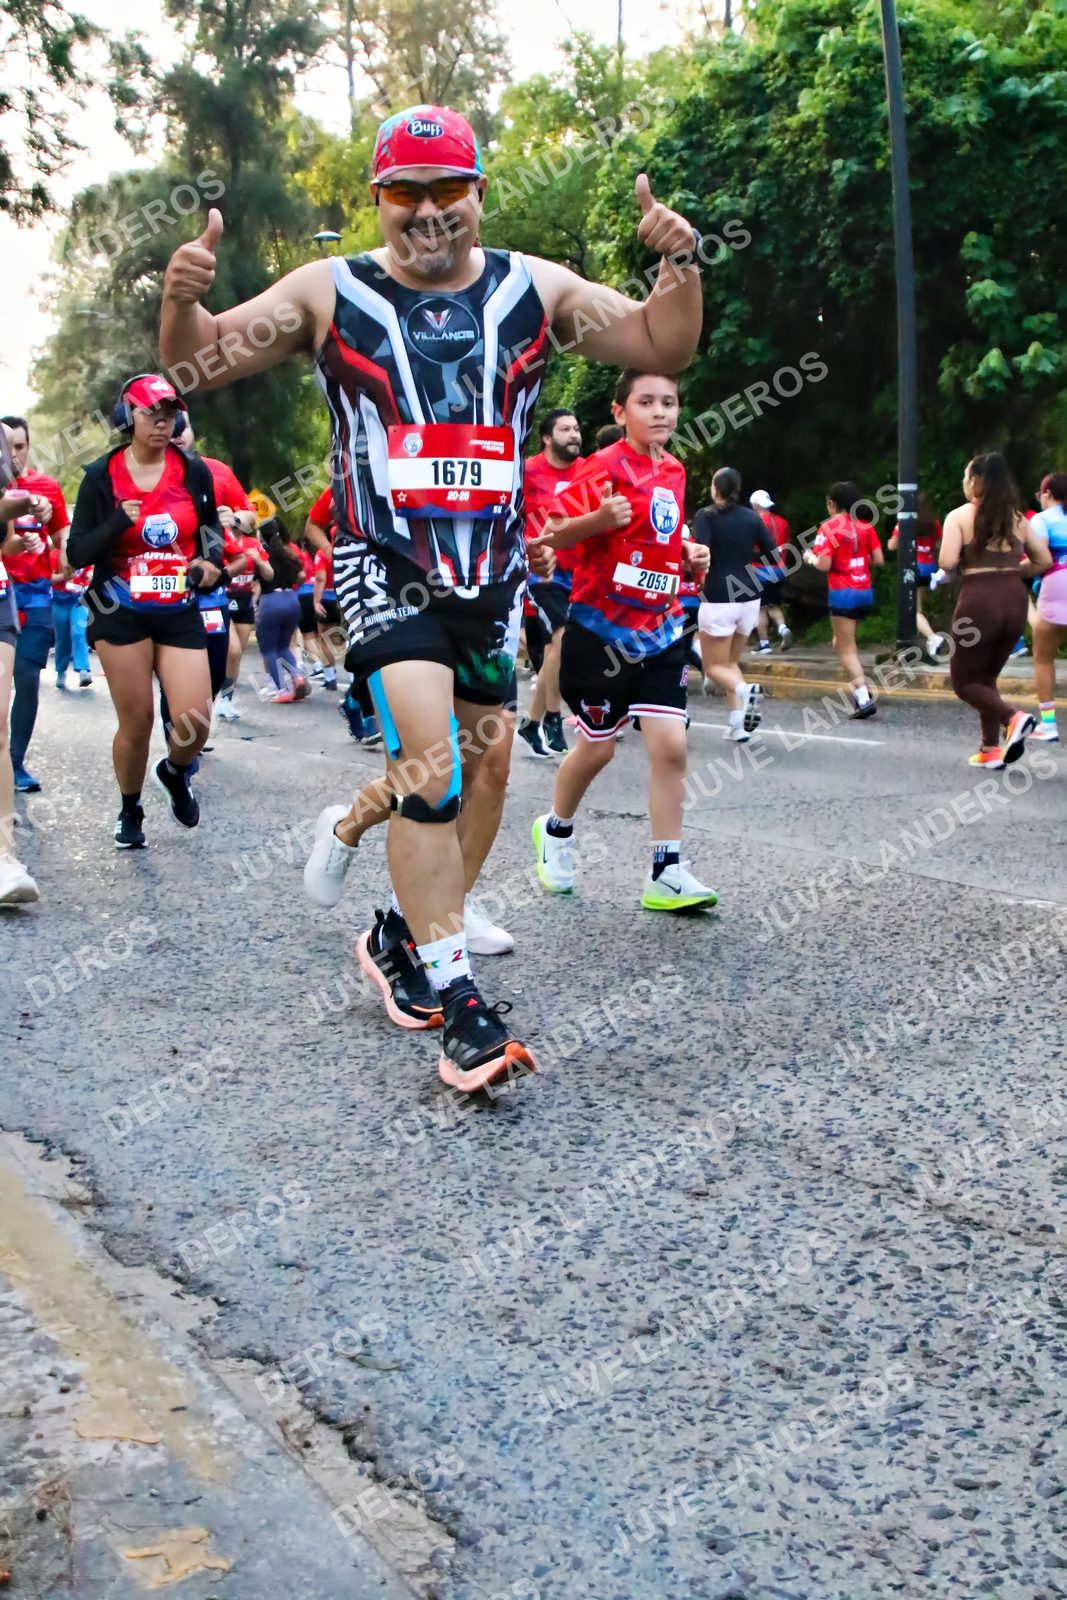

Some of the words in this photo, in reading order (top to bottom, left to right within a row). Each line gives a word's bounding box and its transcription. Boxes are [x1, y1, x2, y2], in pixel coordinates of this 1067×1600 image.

[411, 121, 440, 136] Buff
[431, 460, 482, 486] 1679
[152, 577, 177, 590] 3157
[637, 571, 668, 591] 2053
[364, 608, 397, 627] RUNNING
[397, 605, 419, 617] TEAM
